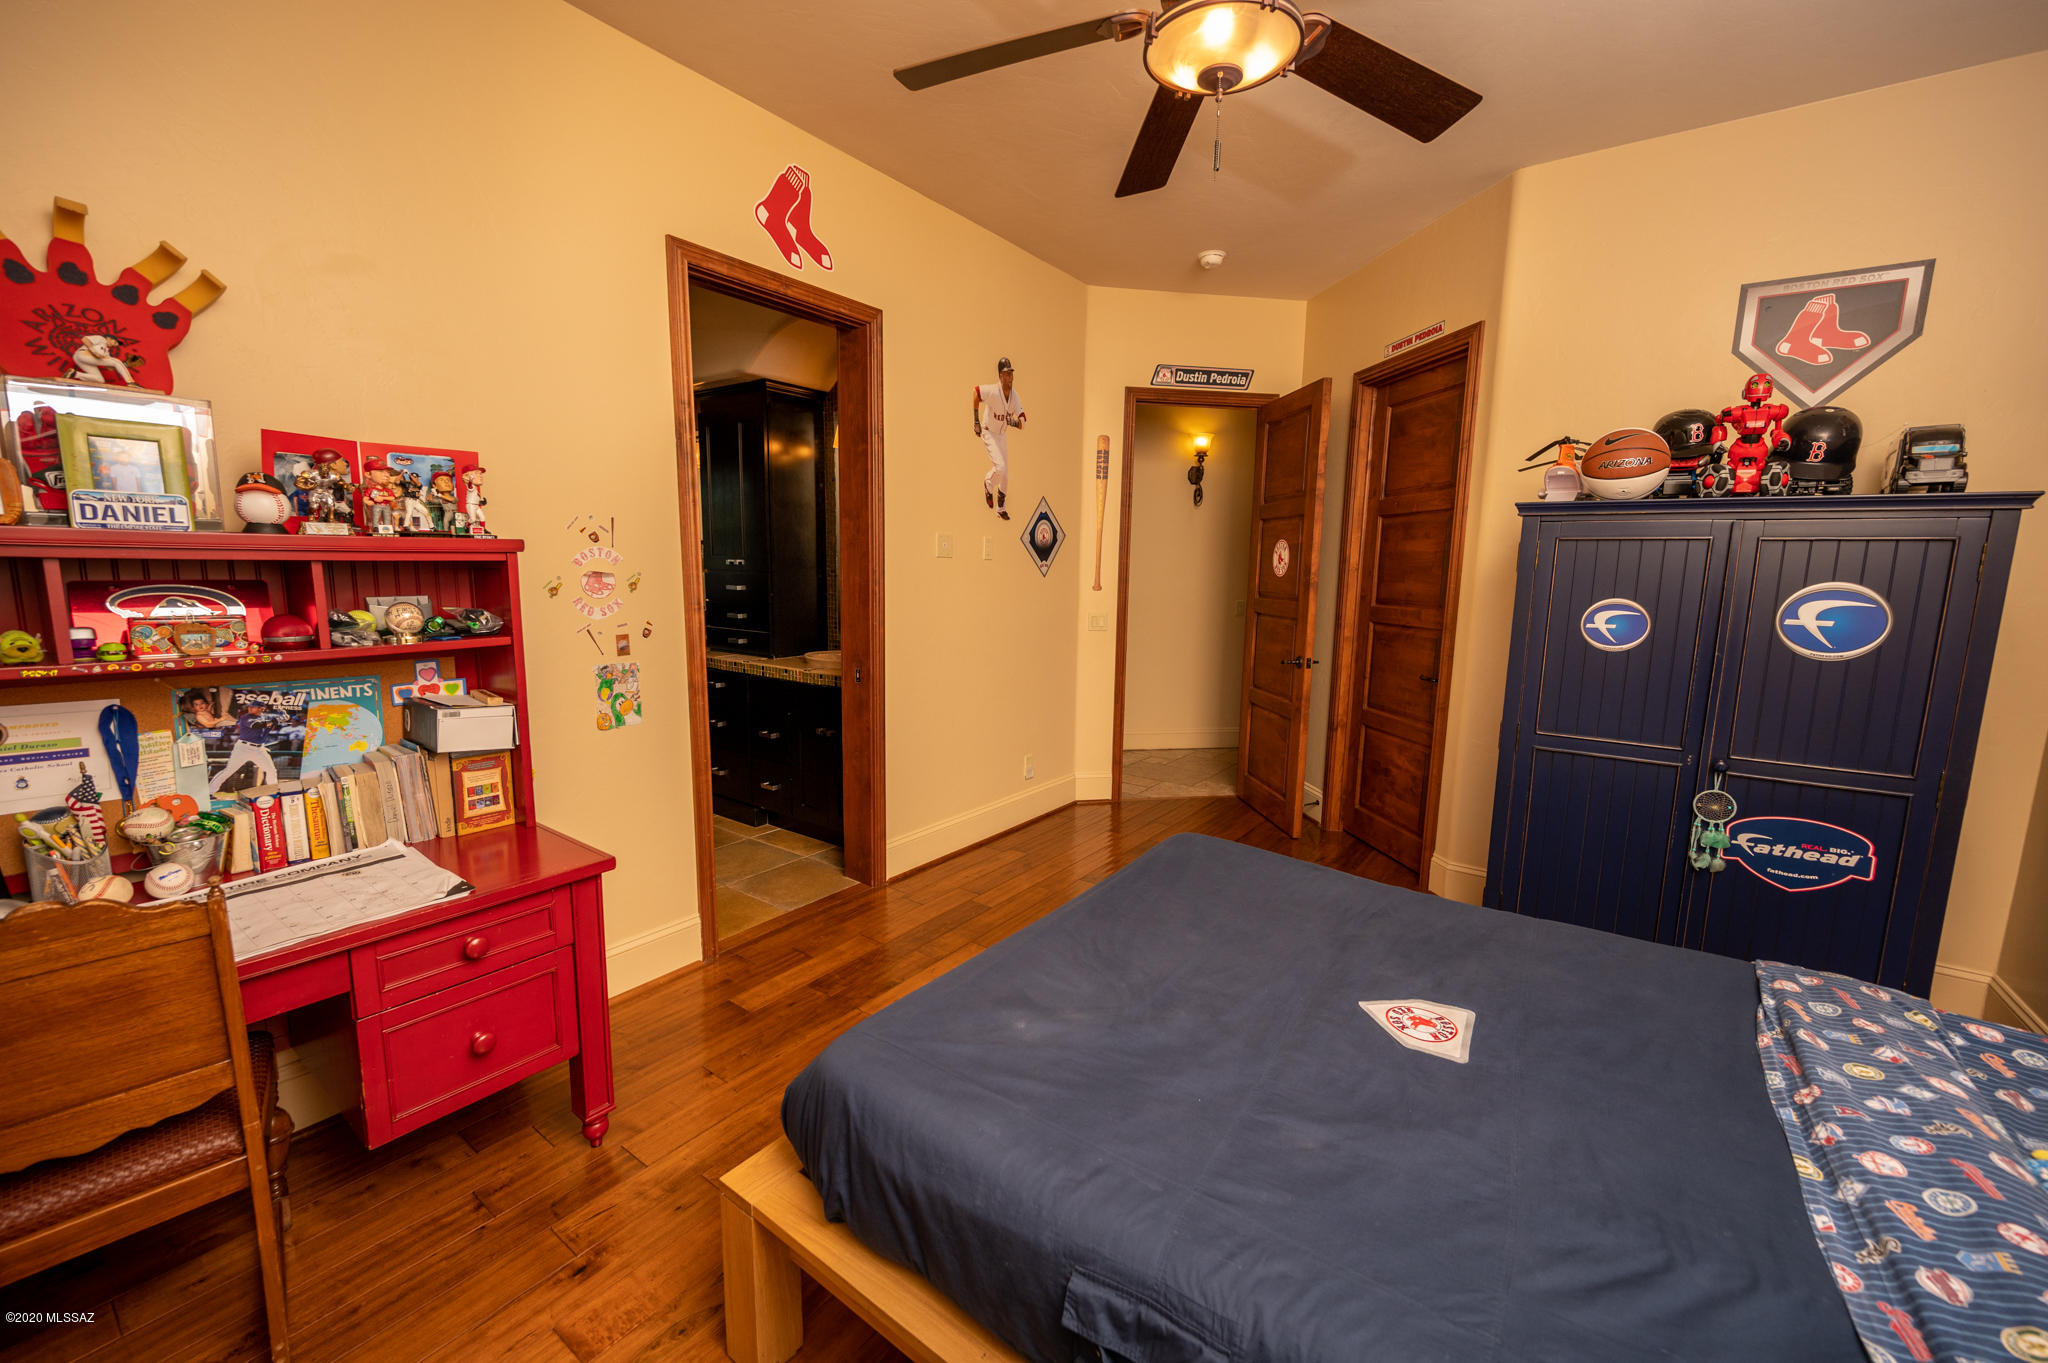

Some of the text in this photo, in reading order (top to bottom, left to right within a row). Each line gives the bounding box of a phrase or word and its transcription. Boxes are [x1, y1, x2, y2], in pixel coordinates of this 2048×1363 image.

[1784, 273, 1885, 291] BOSTON RED SOX
[1176, 371, 1207, 383] Dustin
[1210, 372, 1247, 385] Pedroia
[1689, 423, 1704, 443] B
[1806, 441, 1827, 463] B
[1597, 456, 1653, 470] ARIZONA
[79, 503, 184, 524] DANIEL
[573, 547, 621, 567] BOSTON
[573, 597, 623, 617] RED SOX
[234, 691, 307, 706] aseball
[292, 683, 373, 701] INENTS
[259, 808, 273, 851] Dictionary
[310, 800, 321, 841] Thesaurus
[274, 854, 361, 879] COMPANY
[1766, 867, 1819, 880] fathead.com
